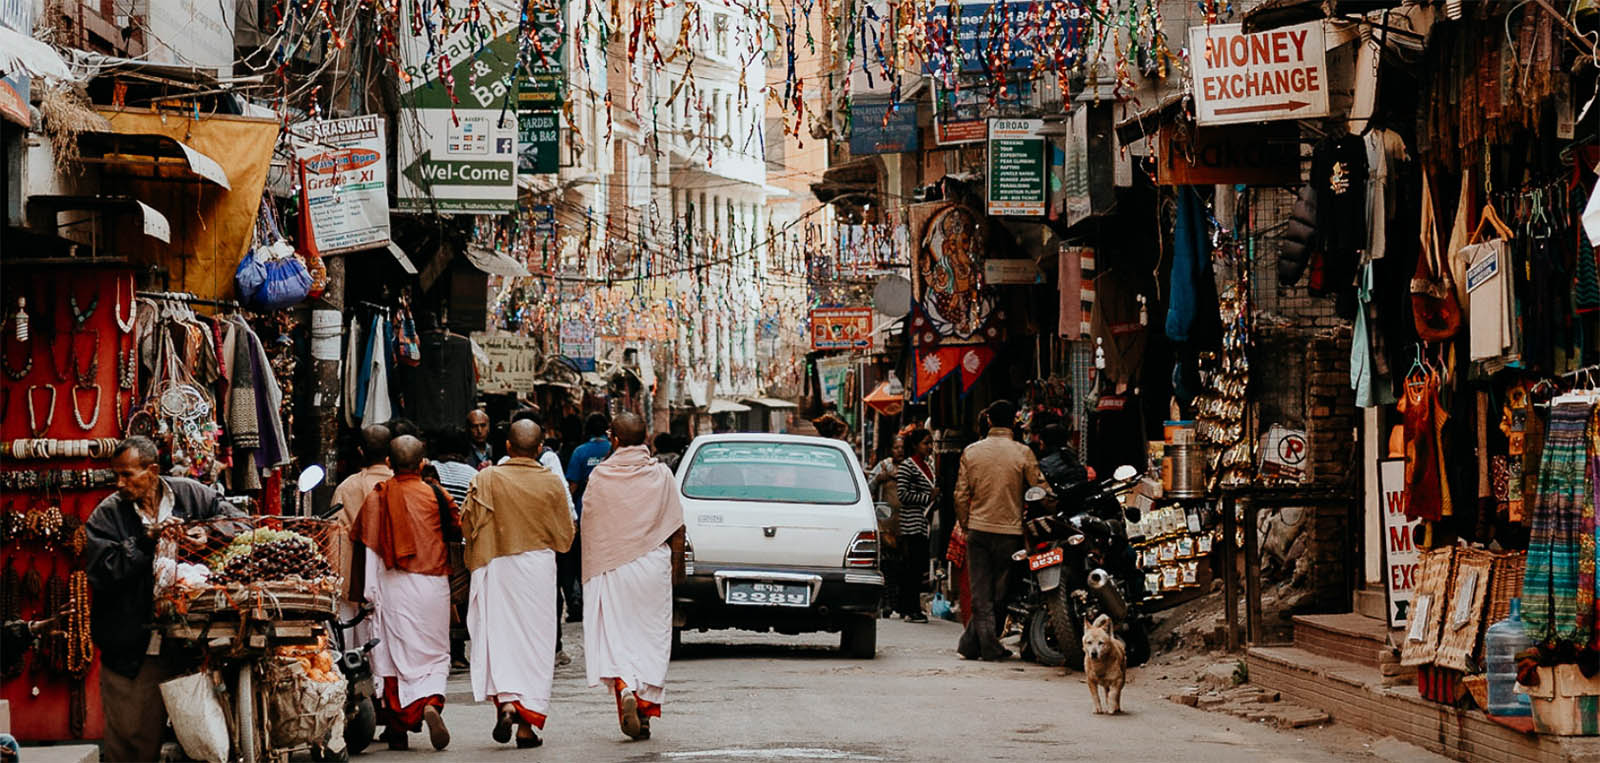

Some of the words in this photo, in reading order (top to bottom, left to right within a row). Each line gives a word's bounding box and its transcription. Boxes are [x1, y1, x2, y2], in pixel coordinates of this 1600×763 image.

[1207, 30, 1308, 68] MONEY
[1203, 67, 1320, 101] EXCHANGE
[305, 118, 376, 139] SARASWATI
[540, 131, 556, 142] BAR
[360, 169, 374, 183] XI
[420, 164, 510, 181] Wel-Come
